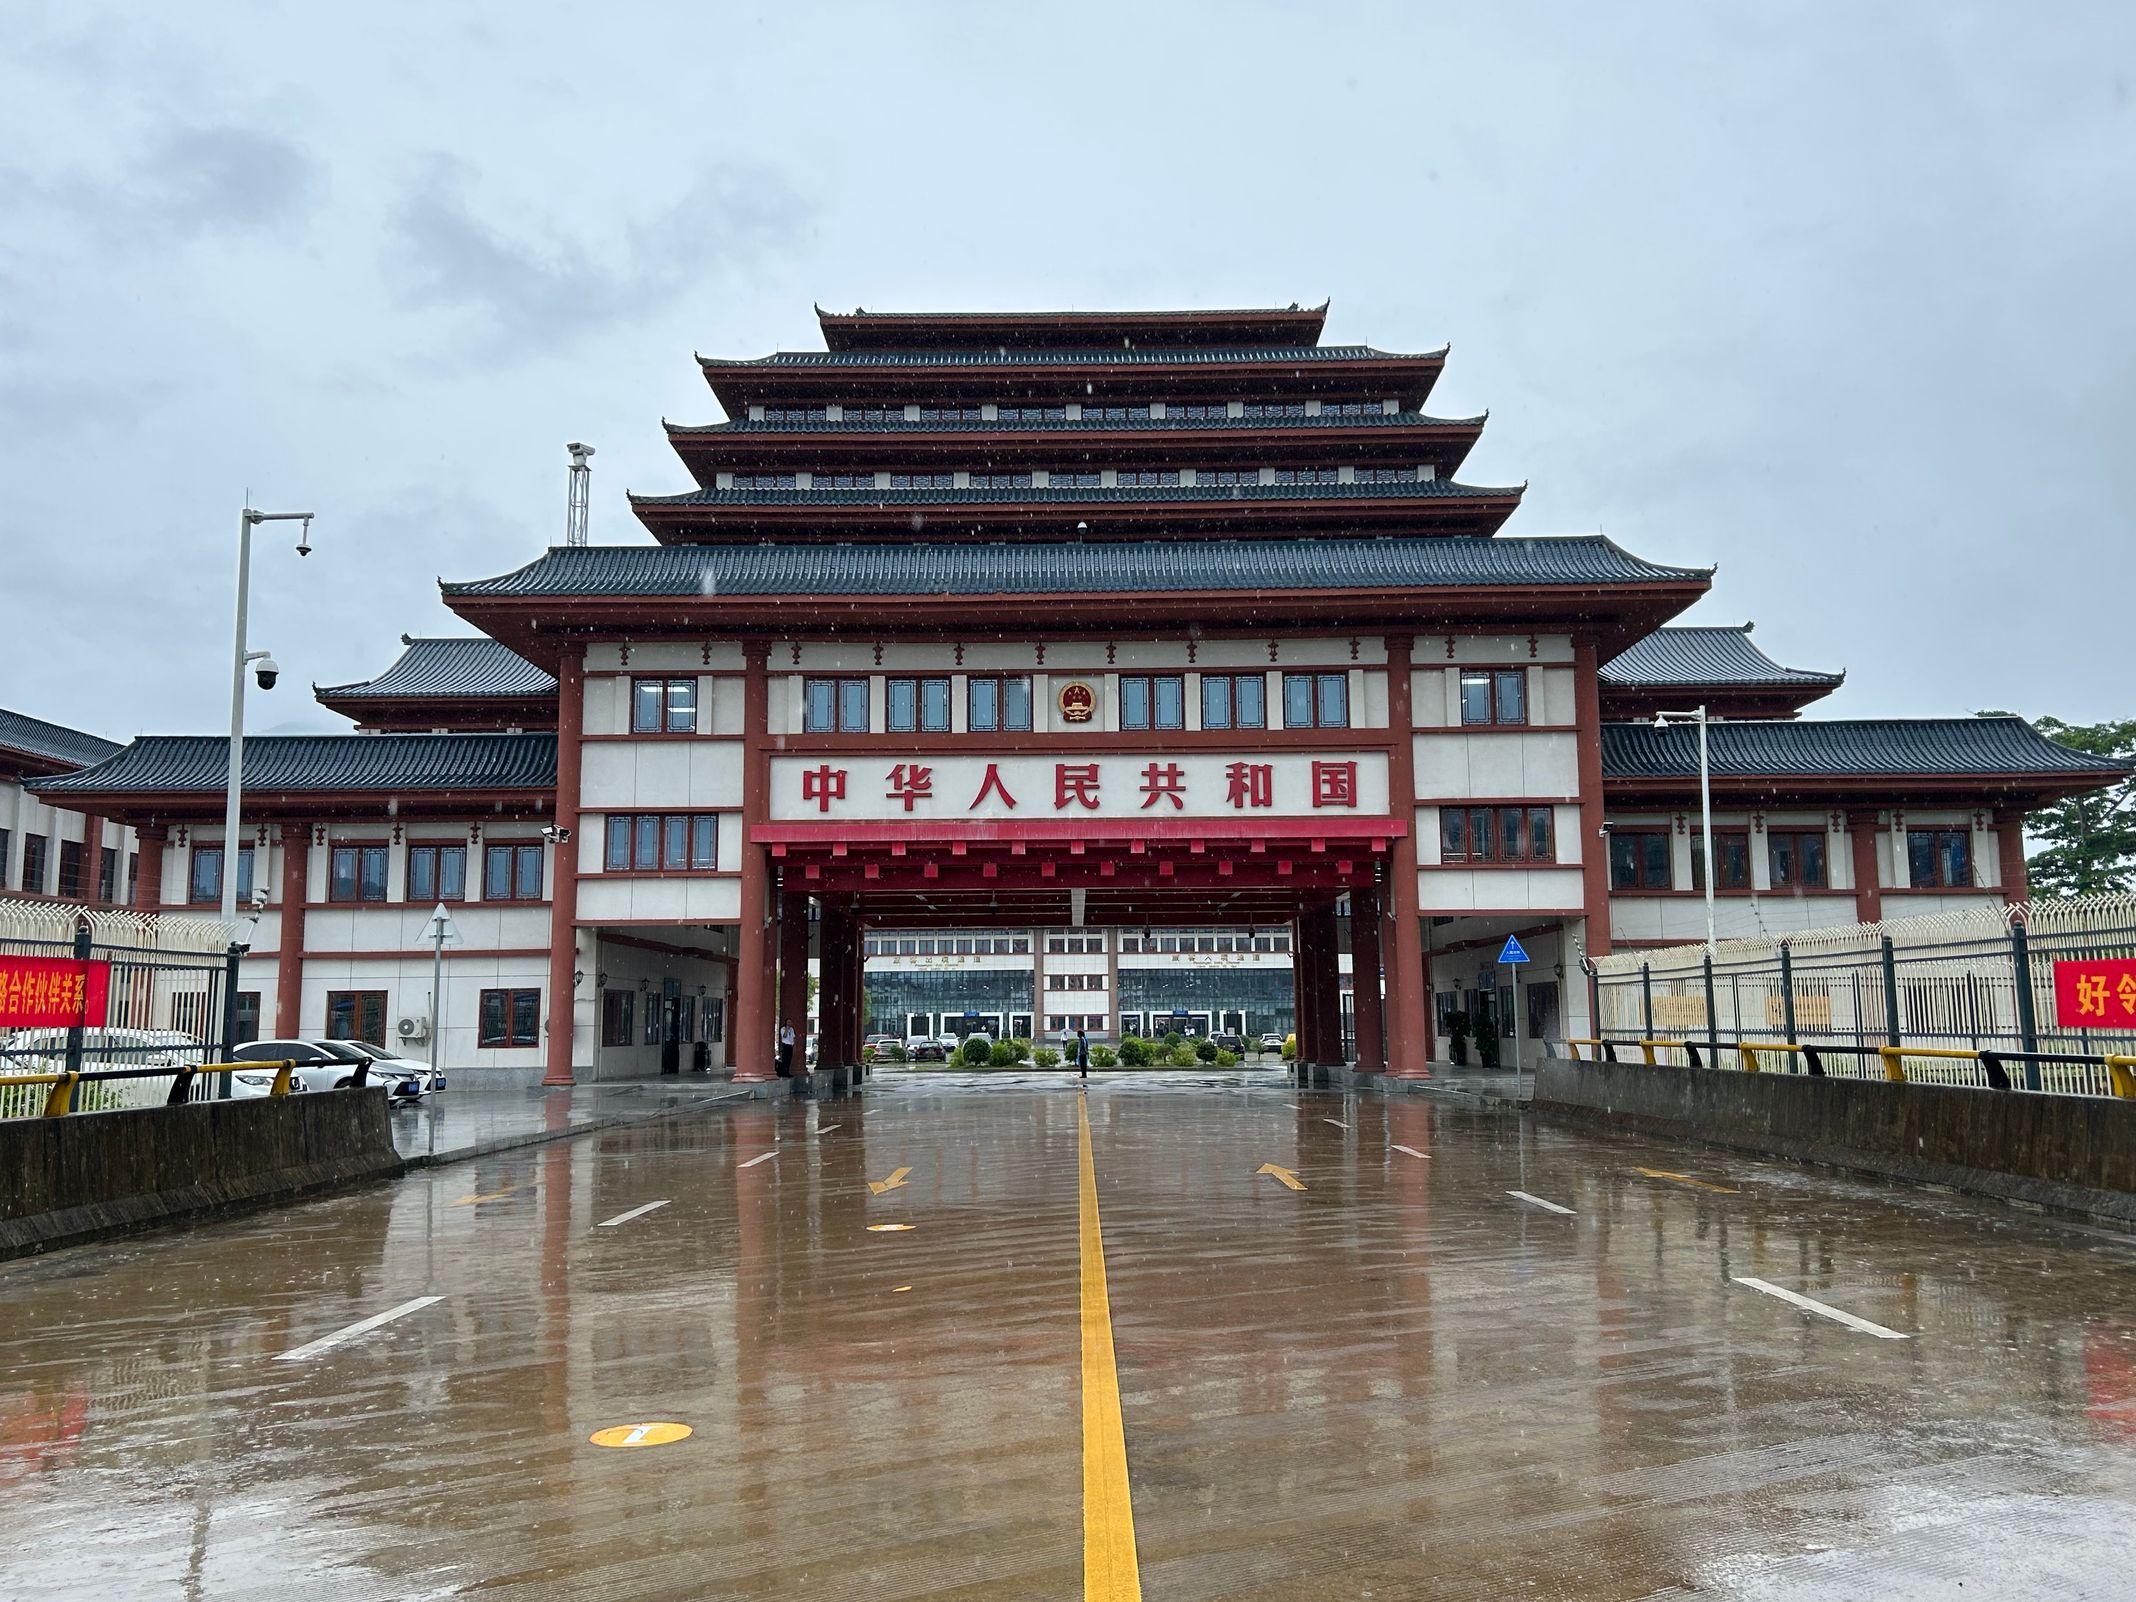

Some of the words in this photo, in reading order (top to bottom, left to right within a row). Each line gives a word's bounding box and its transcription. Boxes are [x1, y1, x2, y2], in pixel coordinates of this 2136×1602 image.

[803, 761, 1358, 811] 中华人民共和国
